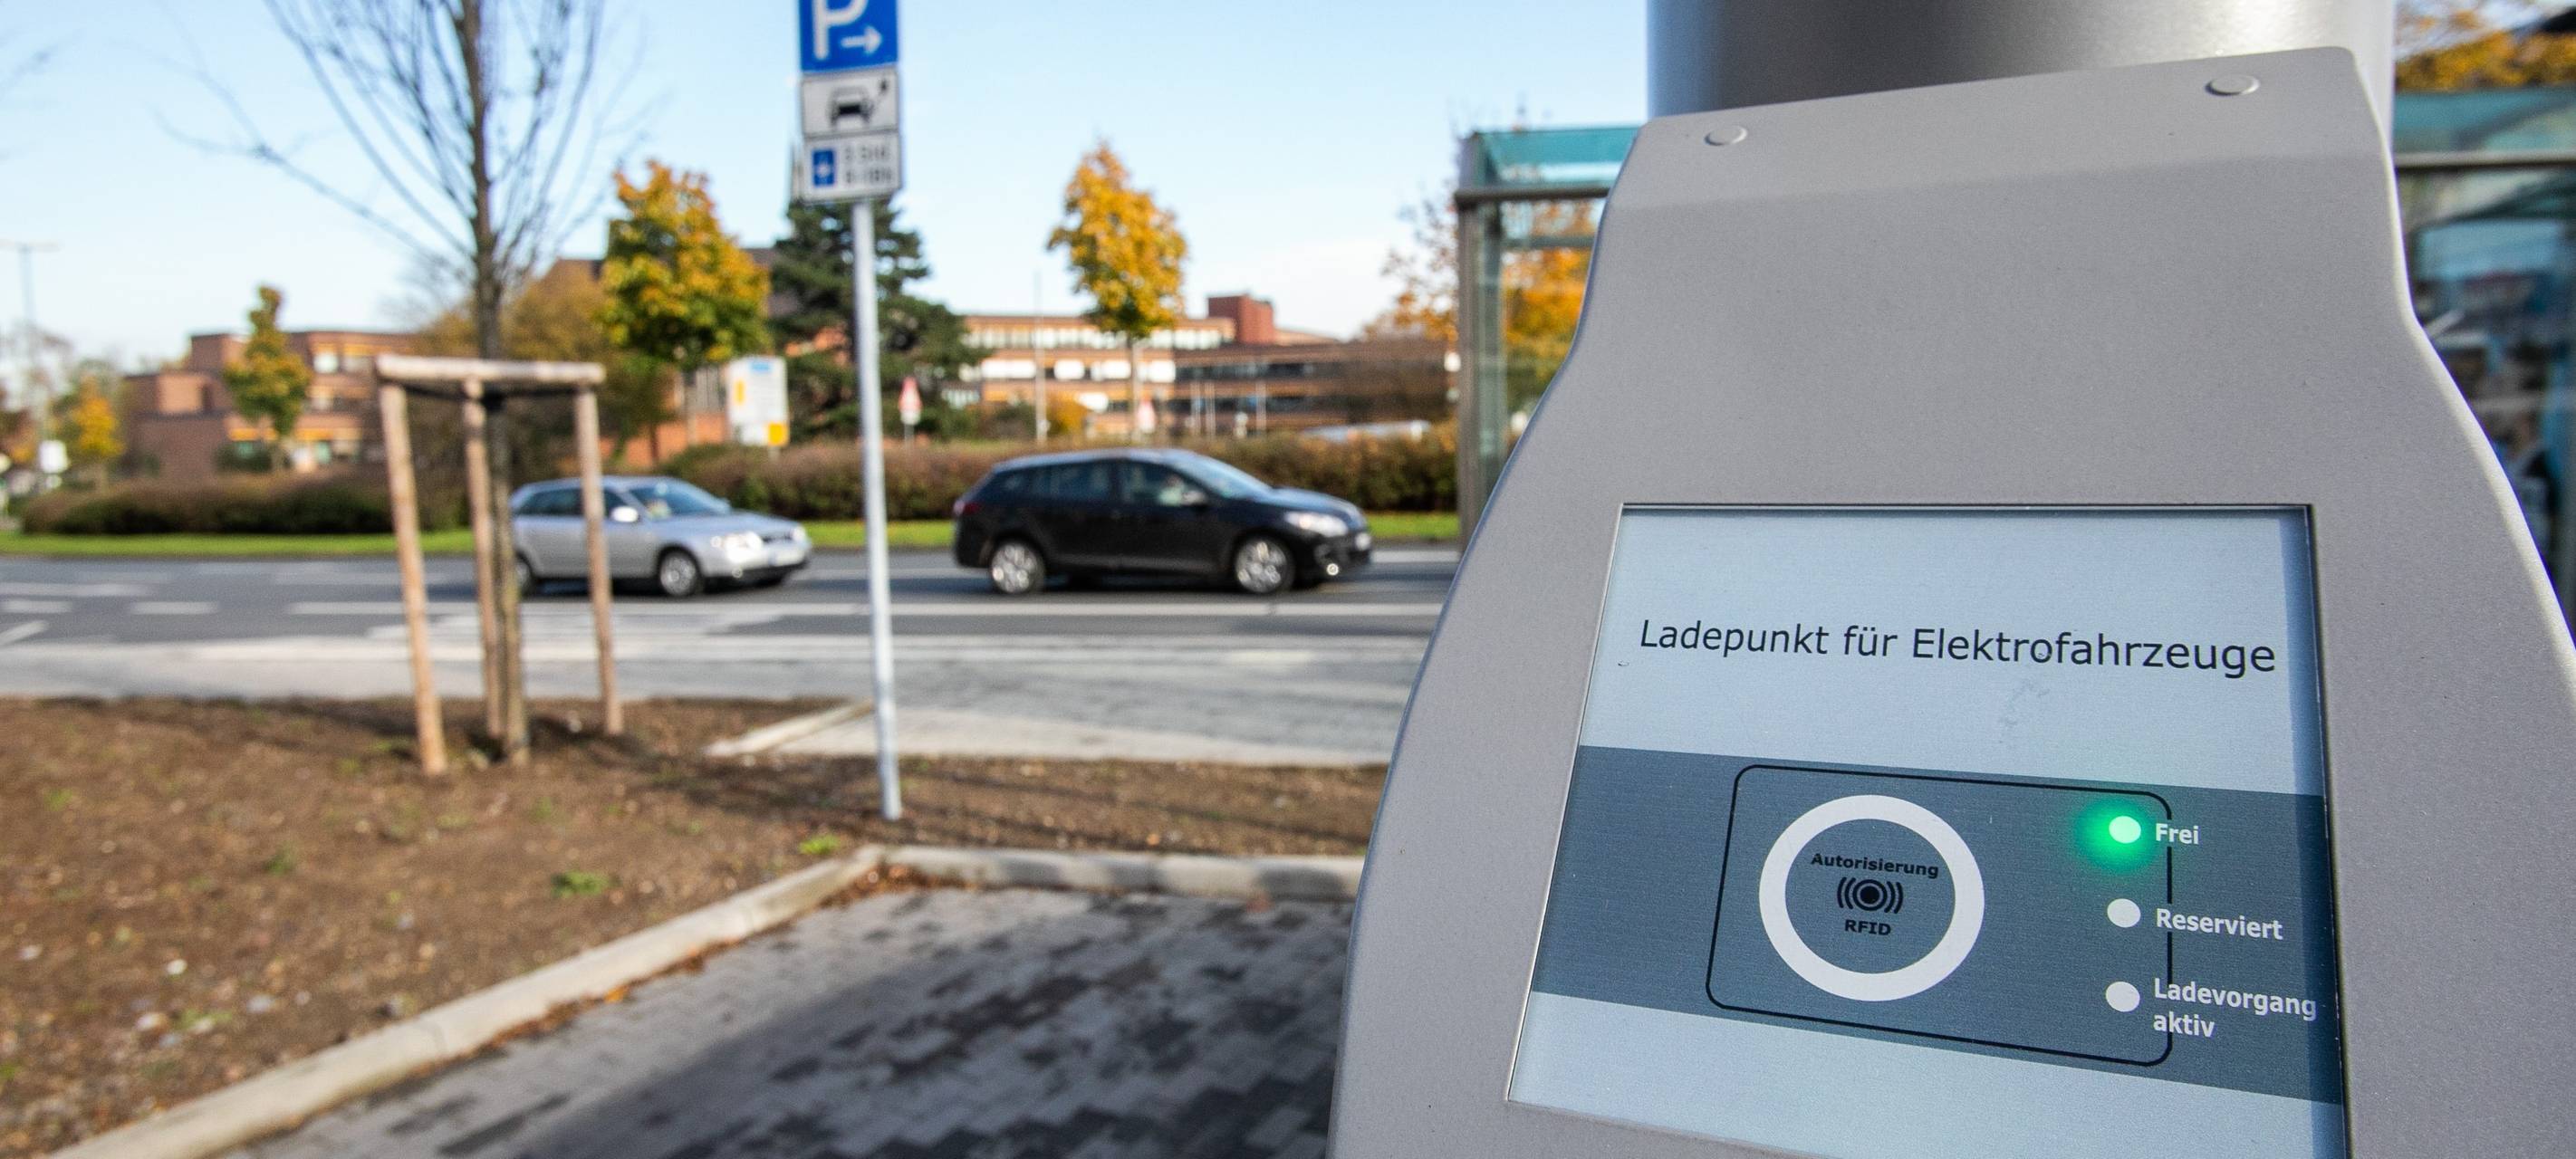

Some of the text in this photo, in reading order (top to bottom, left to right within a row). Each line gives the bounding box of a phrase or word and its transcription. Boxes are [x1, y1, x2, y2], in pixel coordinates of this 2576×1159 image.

[812, 0, 870, 61] P
[1640, 619, 2276, 679] Ladepunkt für Elektrofahrzeuge
[2155, 822, 2200, 846] Frei
[1811, 853, 1940, 879] Autorisierung
[1843, 918, 1892, 937] RFID
[2156, 907, 2284, 941] Reserviert
[2154, 977, 2317, 1021] Ladevorgang
[2153, 1011, 2216, 1038] aktiv
